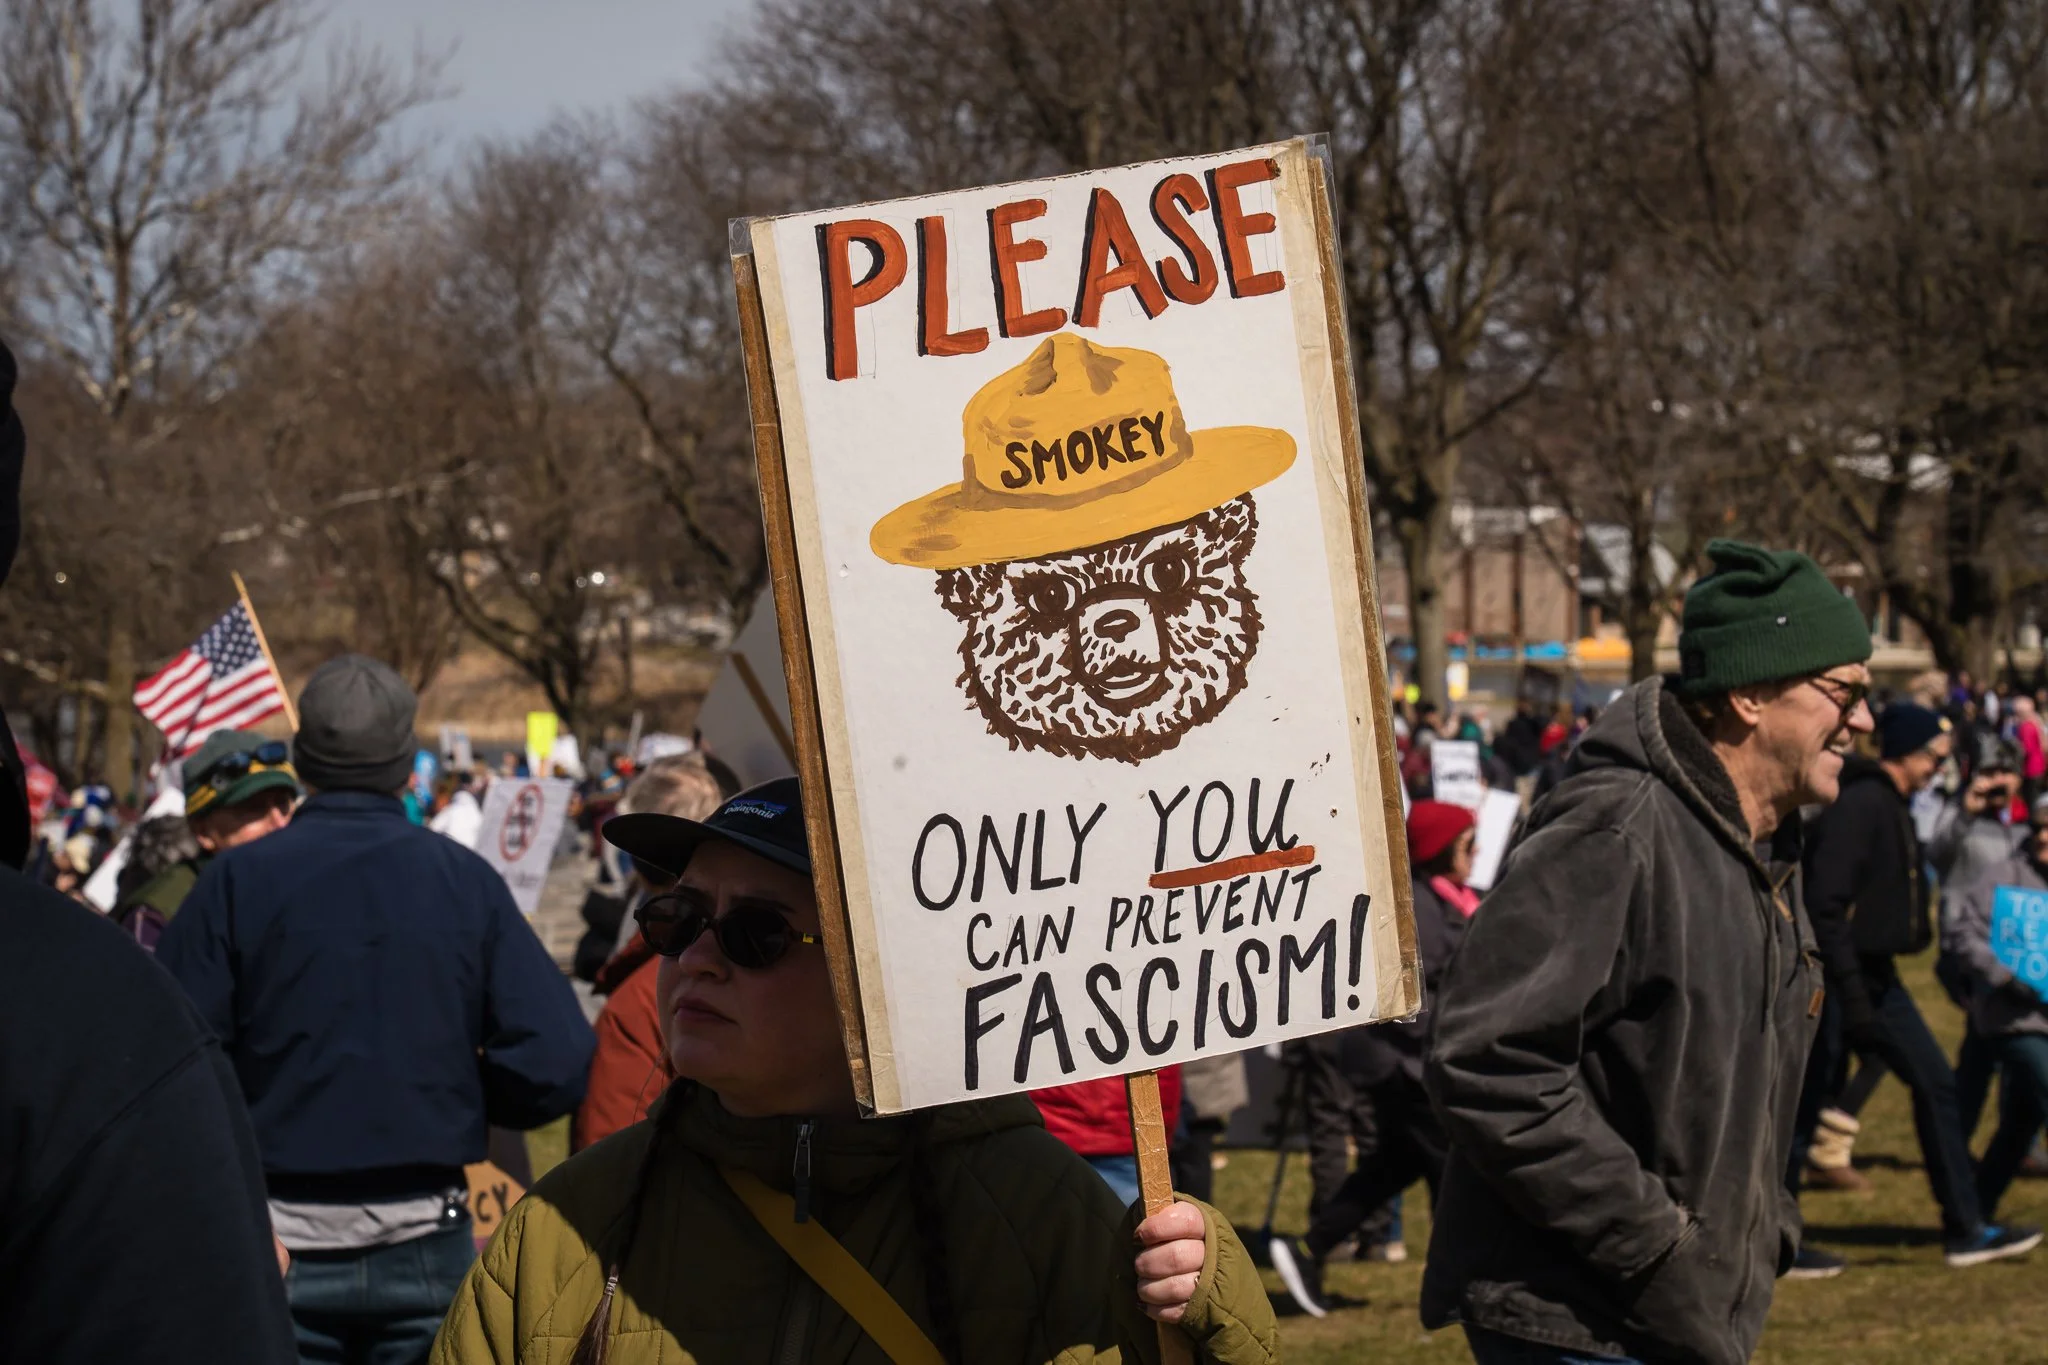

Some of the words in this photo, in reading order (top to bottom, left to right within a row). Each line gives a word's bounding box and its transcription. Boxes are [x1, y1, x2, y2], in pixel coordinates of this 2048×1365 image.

[814, 157, 1286, 381] PLEASE
[1000, 411, 1165, 489] SMOKEY
[724, 804, 776, 819] patagonia
[912, 802, 1107, 911] ONLY
[1149, 778, 1299, 873] YOU
[967, 906, 1075, 971] CAN
[1105, 865, 1321, 952] PREVENT
[964, 894, 1371, 1091] FASCISM!
